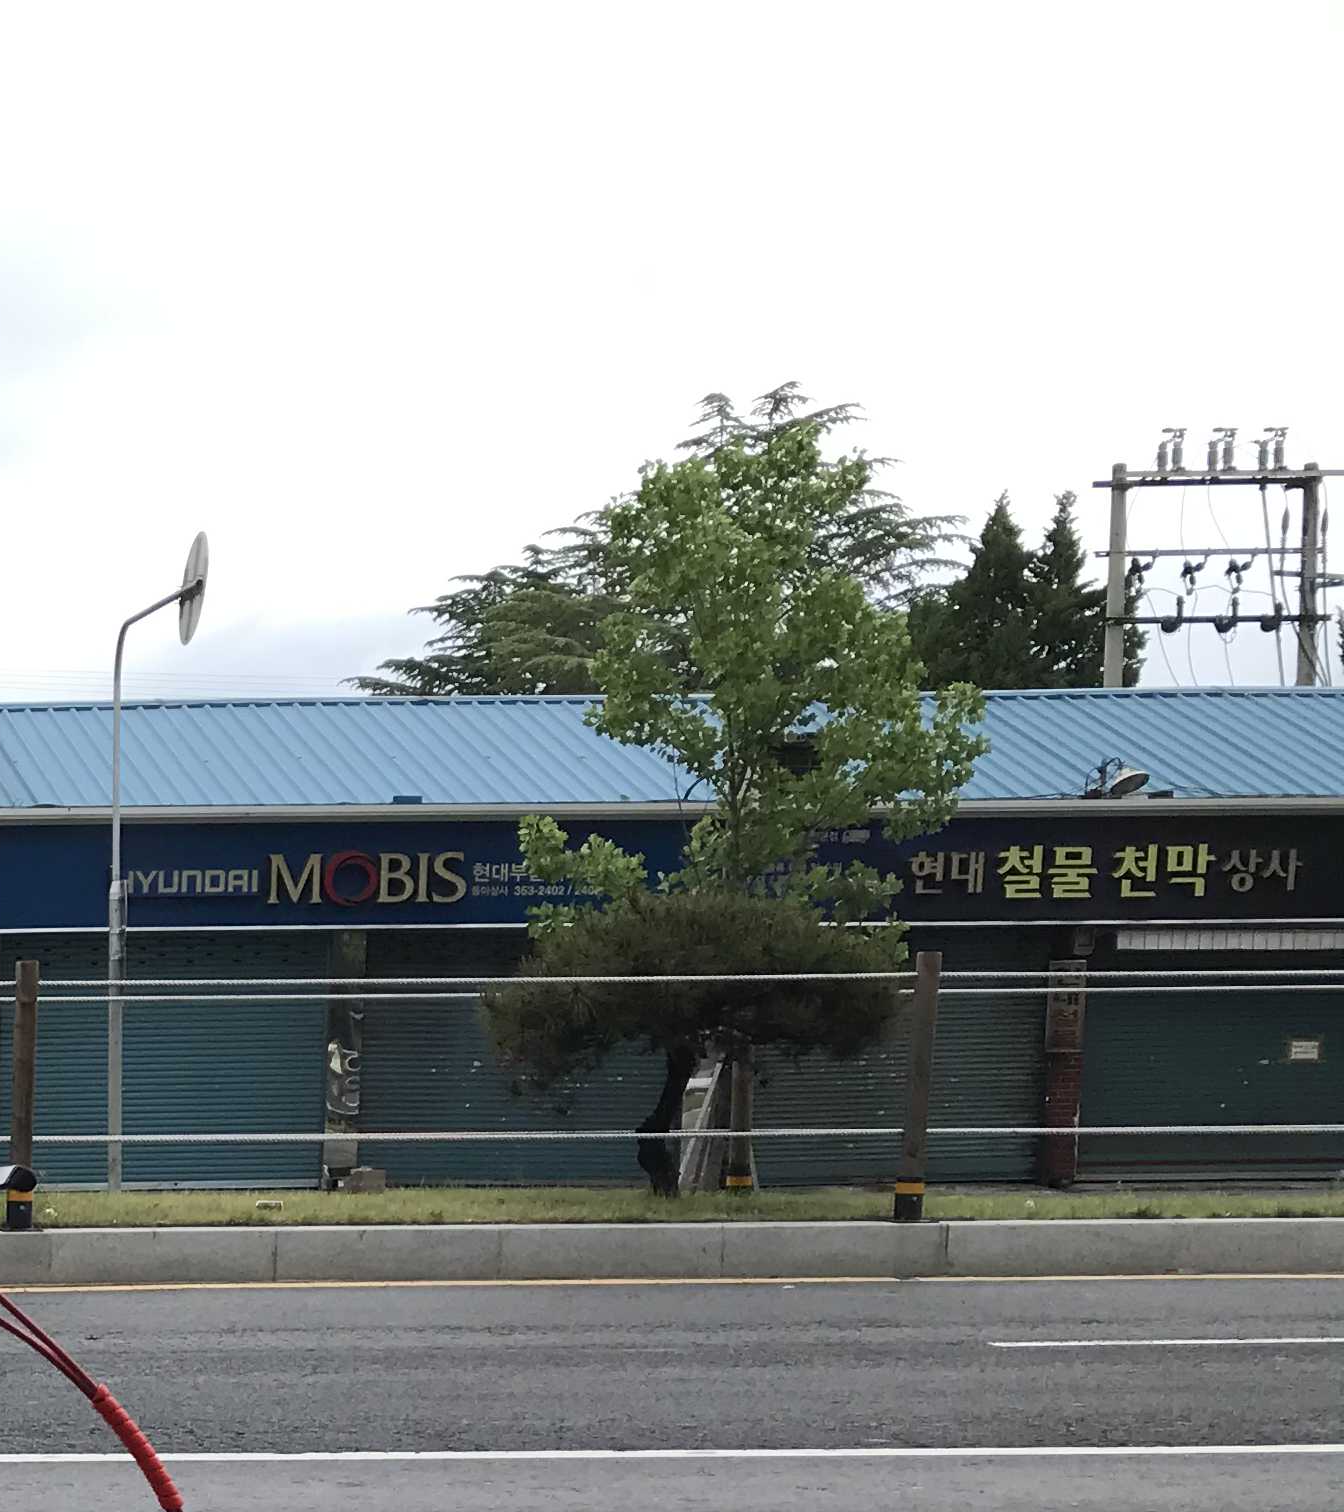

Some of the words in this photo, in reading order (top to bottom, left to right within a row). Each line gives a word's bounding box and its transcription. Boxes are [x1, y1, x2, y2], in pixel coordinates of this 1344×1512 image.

[266, 850, 468, 906] MOBIS
[911, 851, 984, 895] 현대
[996, 844, 1098, 899] 철물
[1113, 843, 1216, 898] 천막
[1222, 849, 1302, 893] 상사
